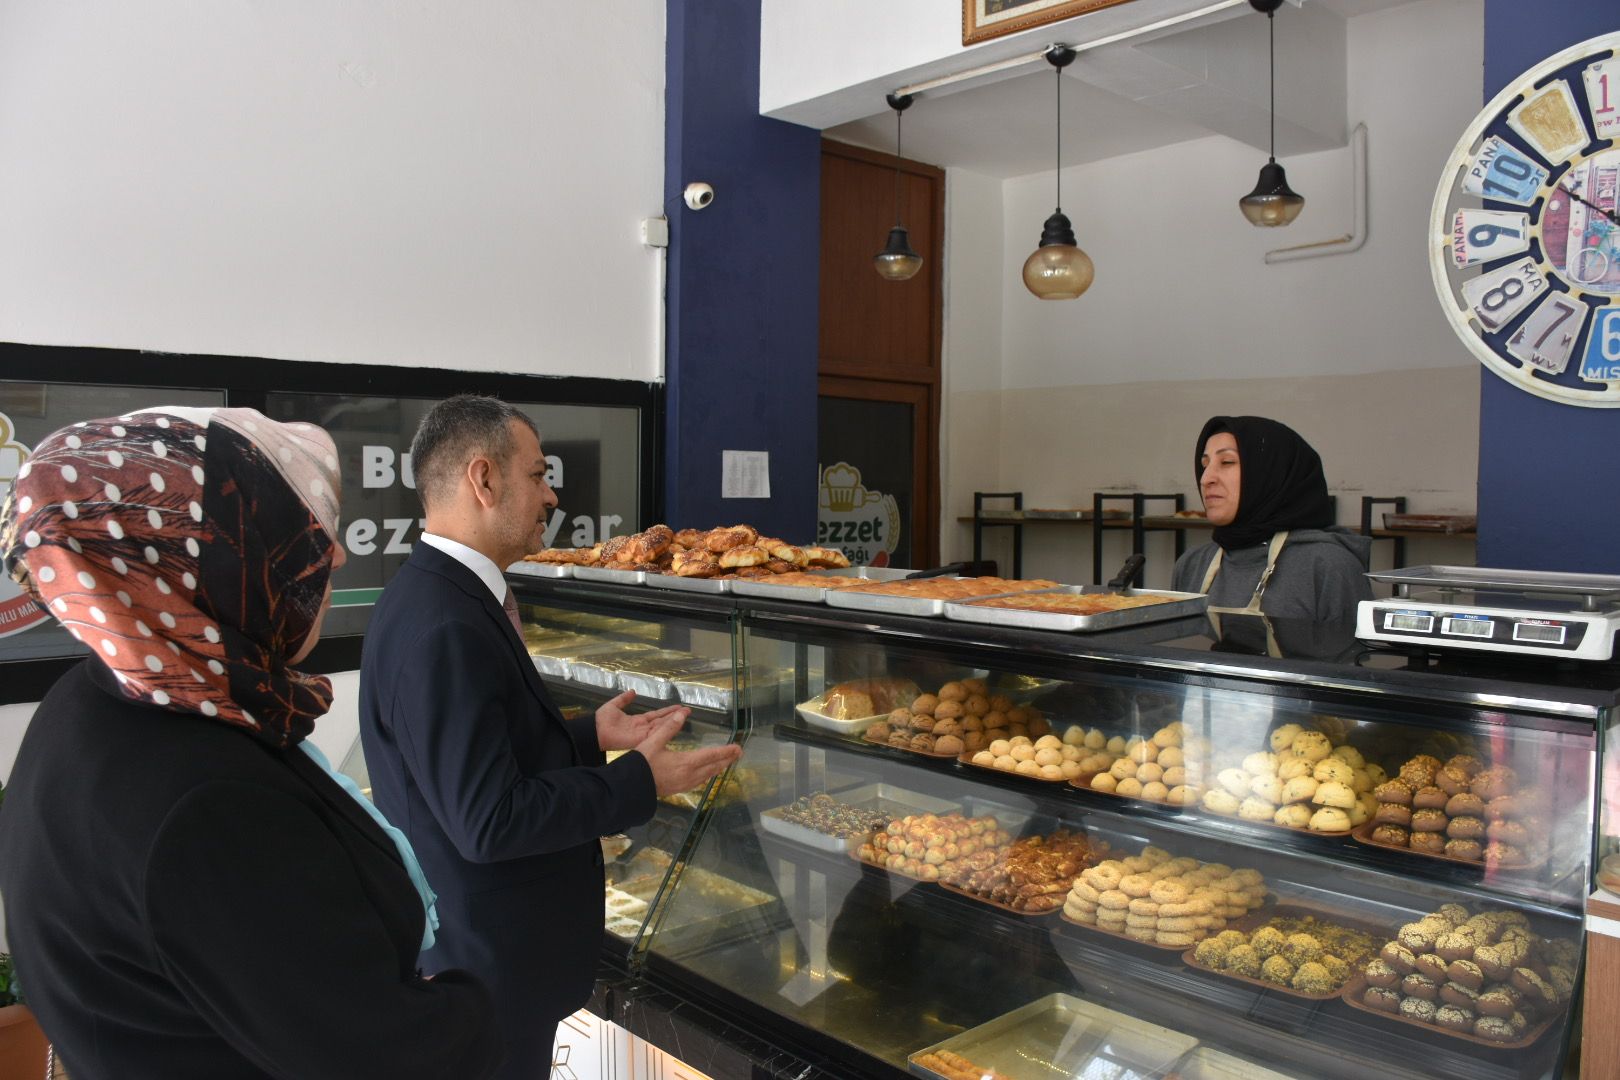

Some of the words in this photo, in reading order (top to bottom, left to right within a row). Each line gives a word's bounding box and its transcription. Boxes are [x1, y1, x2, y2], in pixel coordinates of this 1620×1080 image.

[1482, 154, 1532, 198] 10
[1468, 223, 1521, 248] 9
[1482, 277, 1525, 312] 8
[1534, 301, 1575, 348] 7
[1602, 311, 1620, 361] 6
